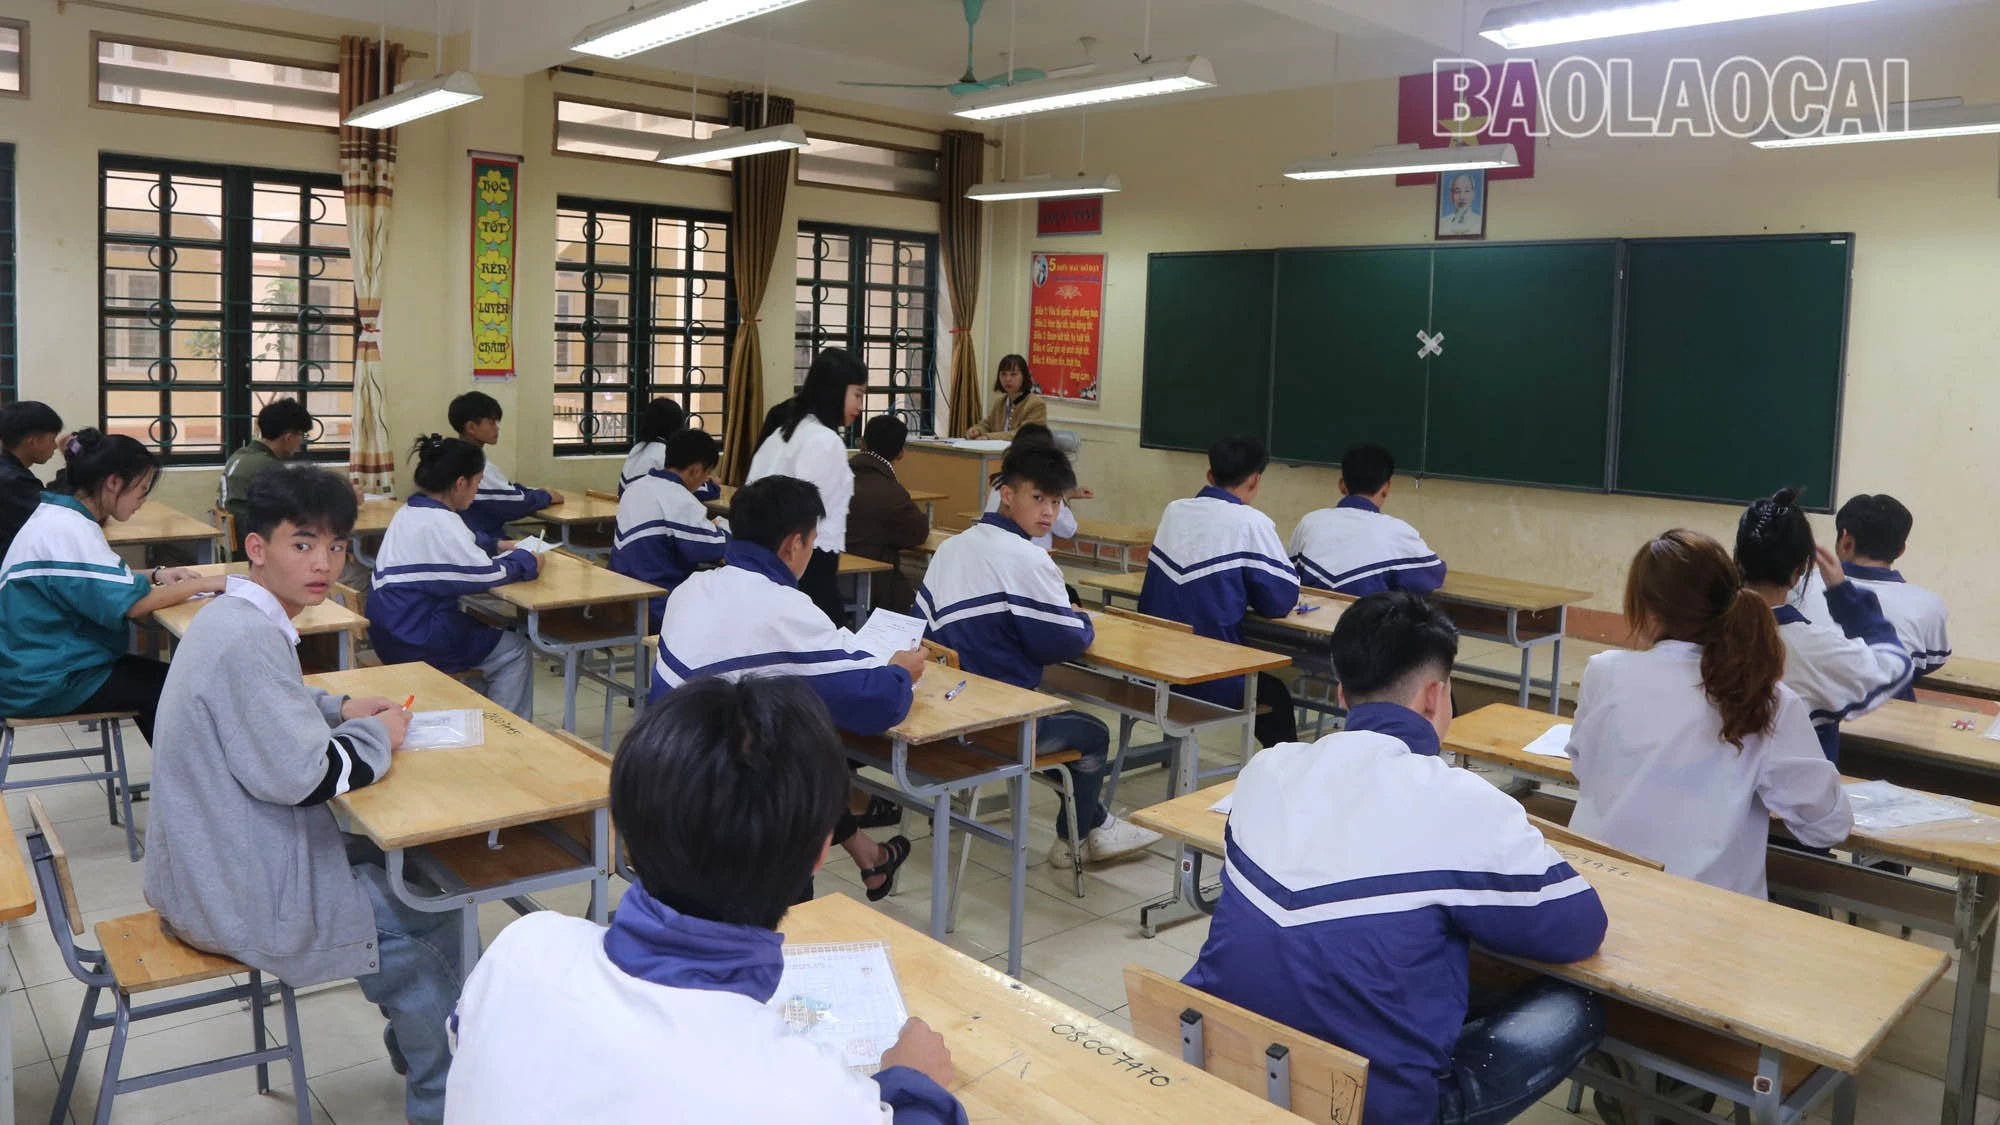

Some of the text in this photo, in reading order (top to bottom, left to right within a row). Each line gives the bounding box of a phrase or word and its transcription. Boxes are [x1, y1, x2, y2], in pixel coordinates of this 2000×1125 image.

[482, 220, 506, 233] TỐT
[1048, 257, 1056, 272] 5
[1051, 1024, 1170, 1087] 08007470
